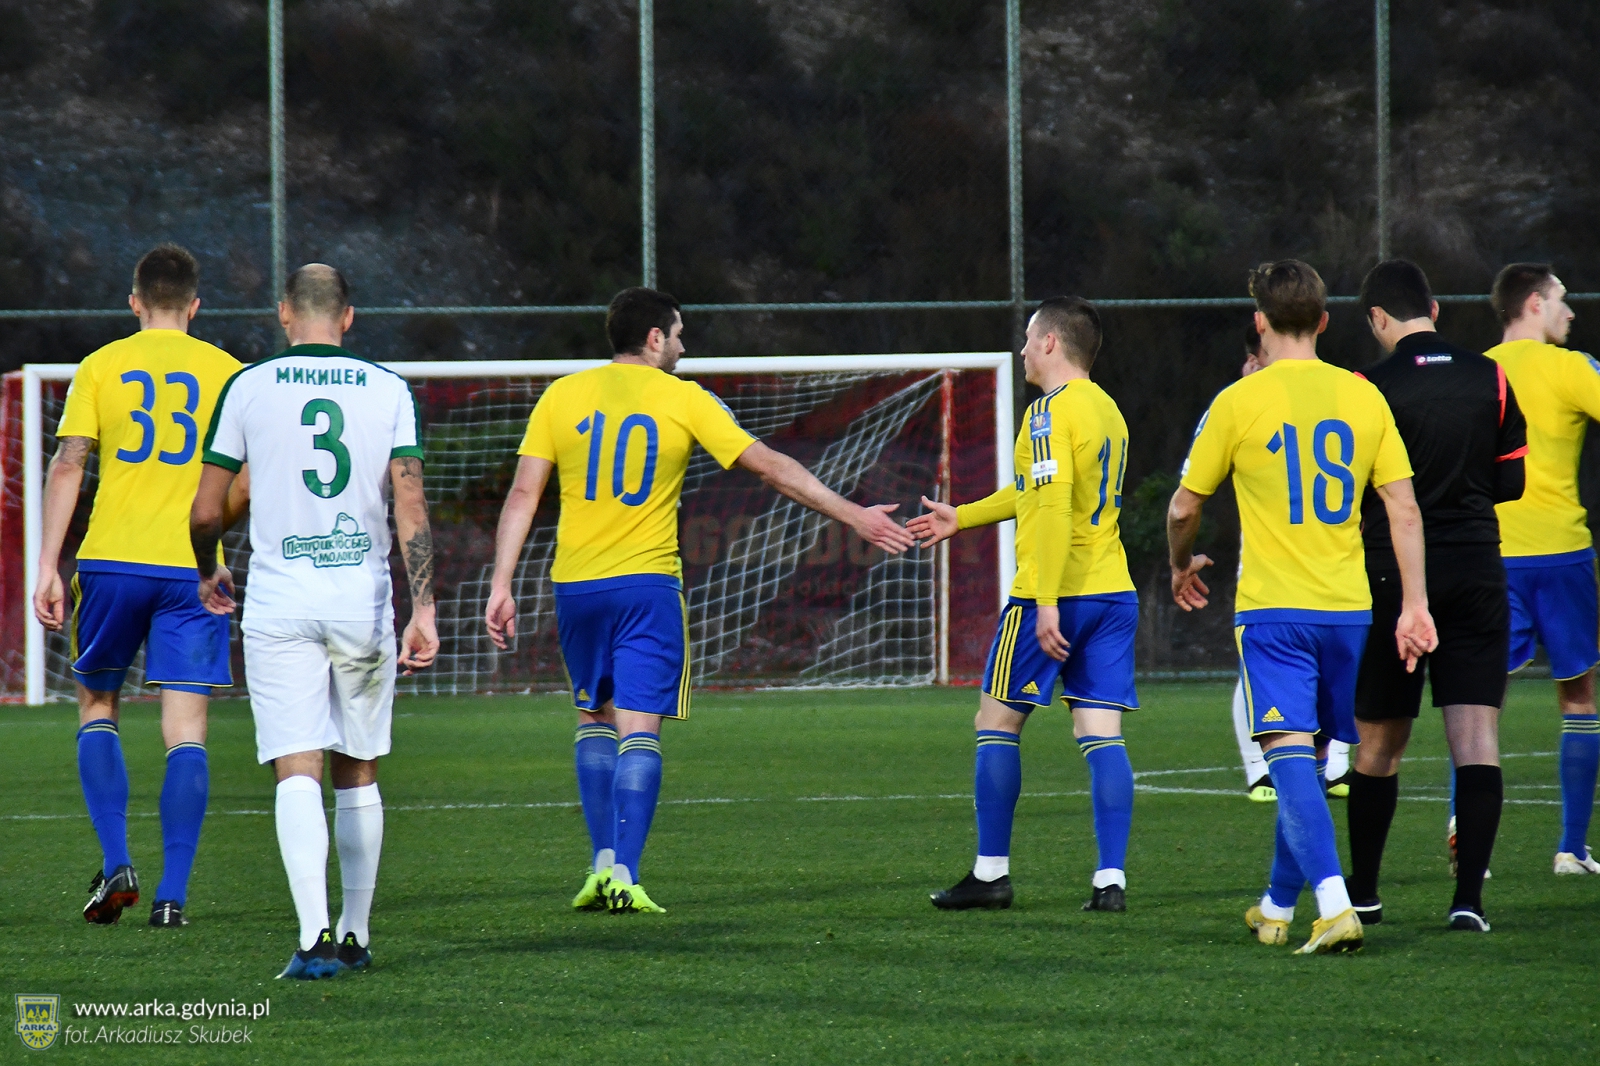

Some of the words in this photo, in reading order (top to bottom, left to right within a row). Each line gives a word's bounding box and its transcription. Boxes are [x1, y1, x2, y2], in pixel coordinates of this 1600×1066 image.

[116, 369, 199, 466] 33
[276, 366, 367, 387] МИКИЦЕЙ
[300, 398, 351, 499] 3
[575, 409, 659, 507] 10
[1266, 418, 1355, 526] 18
